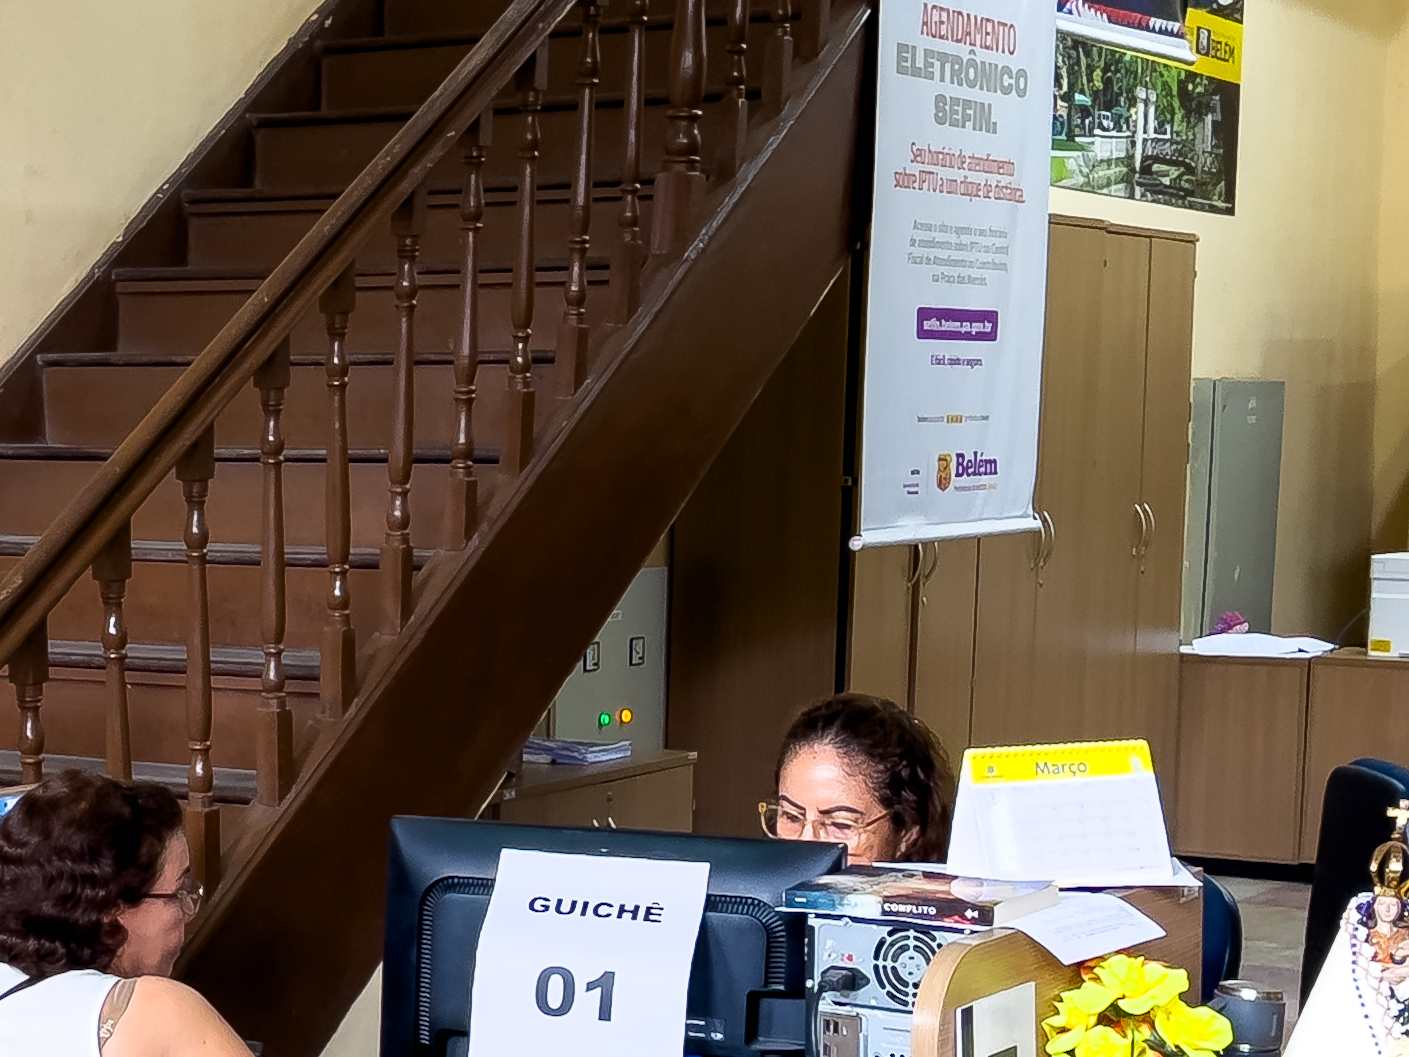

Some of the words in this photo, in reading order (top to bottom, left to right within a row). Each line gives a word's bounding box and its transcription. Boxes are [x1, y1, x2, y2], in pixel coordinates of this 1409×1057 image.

[920, 2, 1017, 55] AGENDAMENTO
[896, 42, 1028, 98] ELETRÔNICO
[934, 93, 998, 134] SEFIN.
[955, 451, 998, 477] Belém
[1035, 761, 1088, 777] Março
[528, 896, 665, 923] GUICHÊ
[883, 903, 937, 915] CONFLITO
[535, 966, 616, 1022] 01
